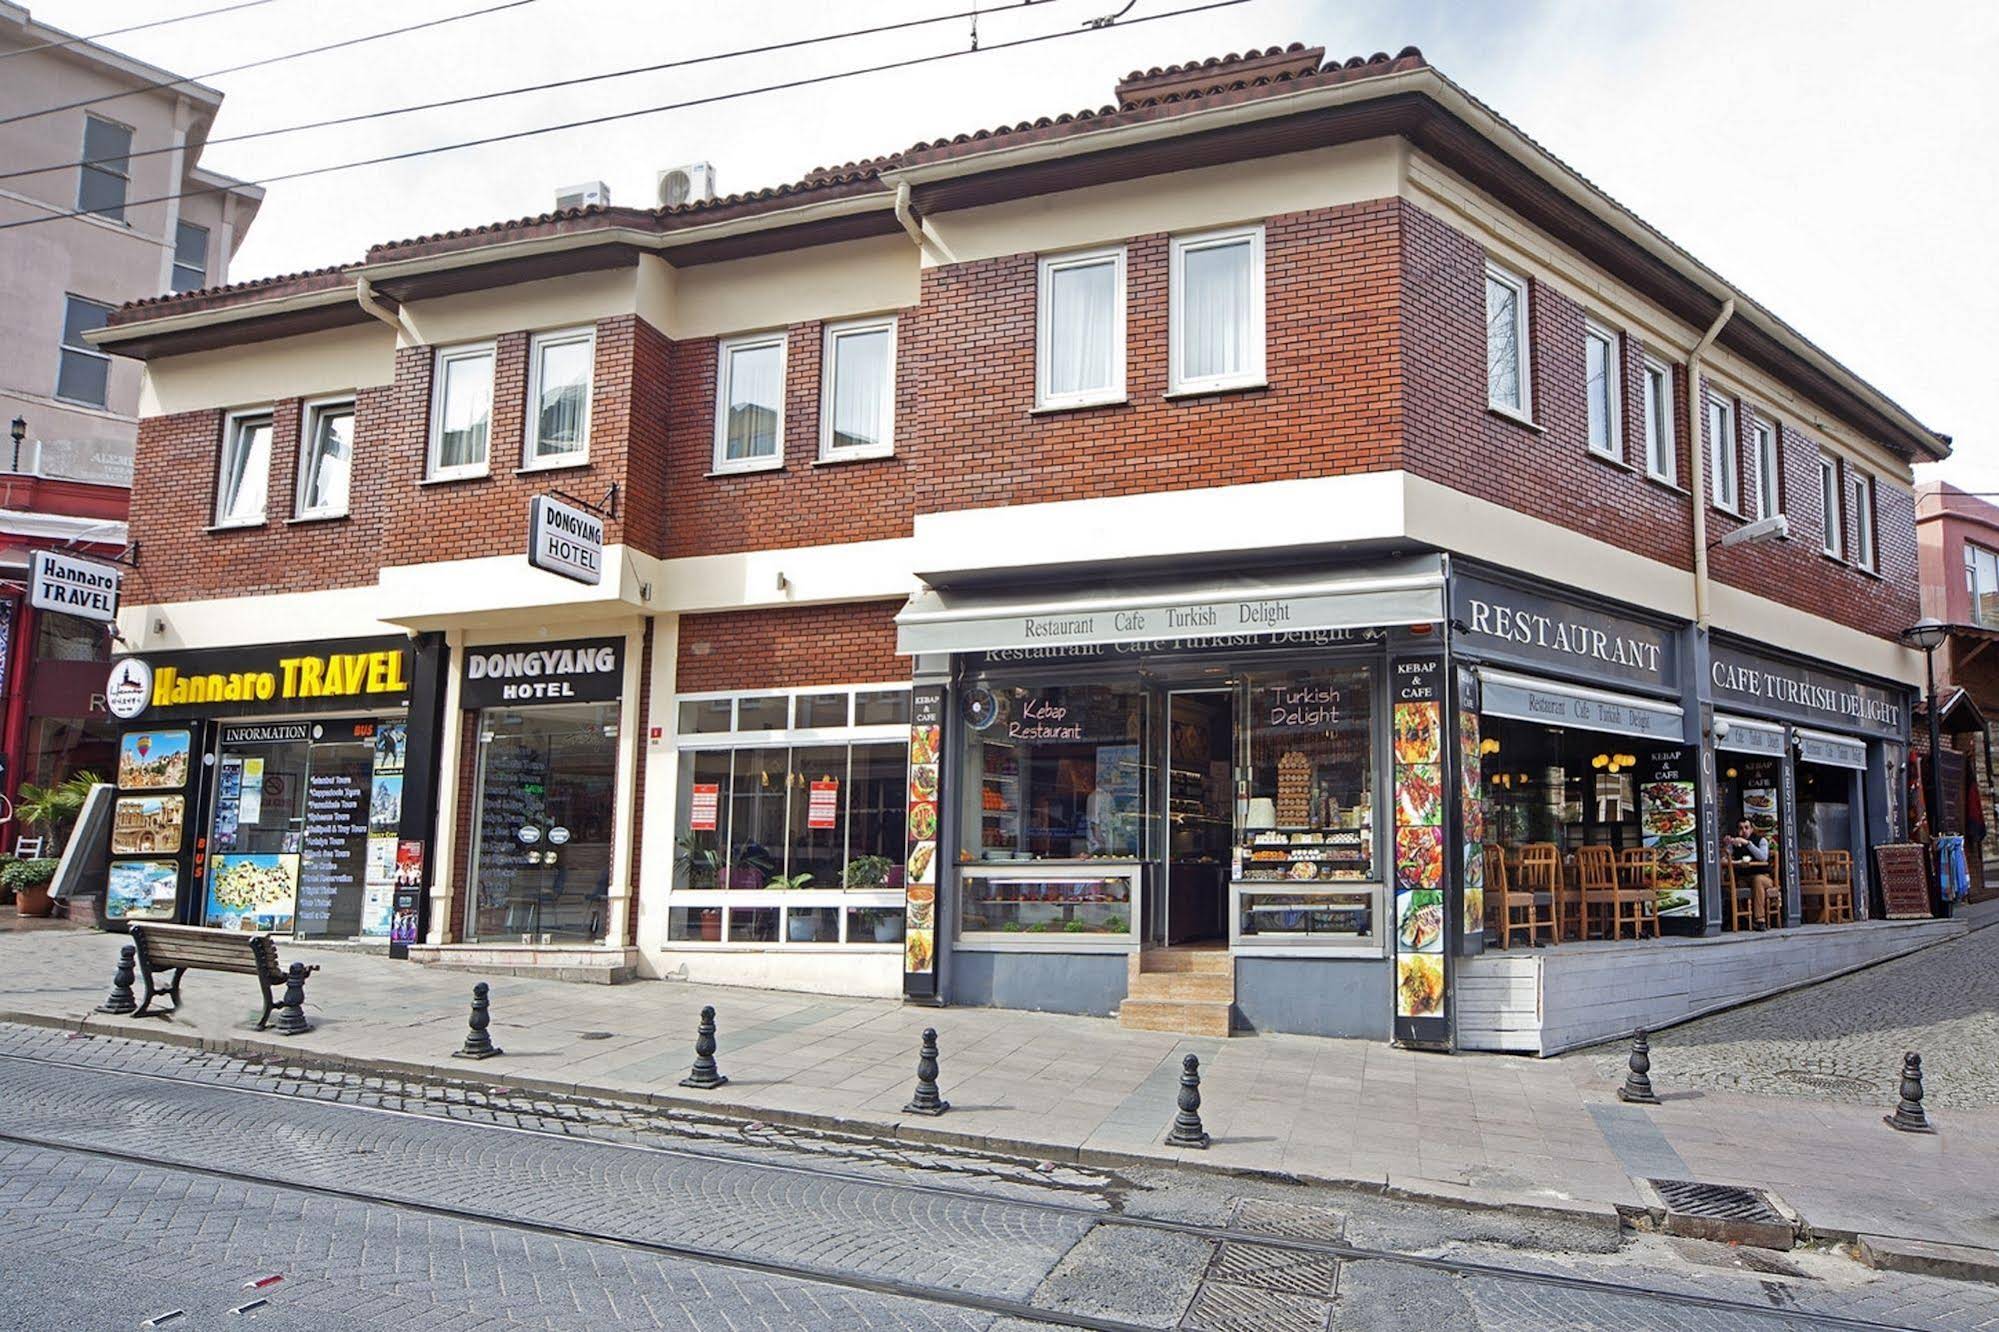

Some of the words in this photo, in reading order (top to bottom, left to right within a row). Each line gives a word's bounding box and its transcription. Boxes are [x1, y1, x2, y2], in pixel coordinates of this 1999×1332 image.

[547, 506, 601, 544] DONGYANG
[549, 538, 596, 569] HOTEL
[44, 558, 113, 589] Hannaro
[42, 582, 111, 612] TRAVEL
[1025, 617, 1093, 637] Restaurant
[1114, 611, 1145, 632] Cafe
[1165, 606, 1217, 628] Turkish
[1239, 601, 1291, 627] Delight
[1469, 599, 1661, 672] RESTAURANT
[468, 647, 616, 679] DONGYANG
[1397, 662, 1436, 674] KEBAP
[152, 667, 276, 706] Hannaro
[280, 650, 408, 698] TRAVEL
[503, 682, 575, 700] HOTEL
[1411, 676, 1422, 685] &
[1270, 686, 1340, 705] Turkish
[1401, 687, 1433, 698] CAFE
[1712, 661, 1761, 697] CAFE
[1763, 673, 1837, 712] TURKISH
[1840, 692, 1900, 726] DELIGHT
[1023, 698, 1067, 721] Kebap
[1271, 705, 1340, 726] Delight
[227, 725, 307, 741] INFORMATION
[353, 725, 374, 736] BUS
[1008, 720, 1082, 740] Restaurant
[1651, 751, 1682, 761] KEBAP
[1703, 752, 1716, 864] CAFE
[195, 838, 206, 878] BUS
